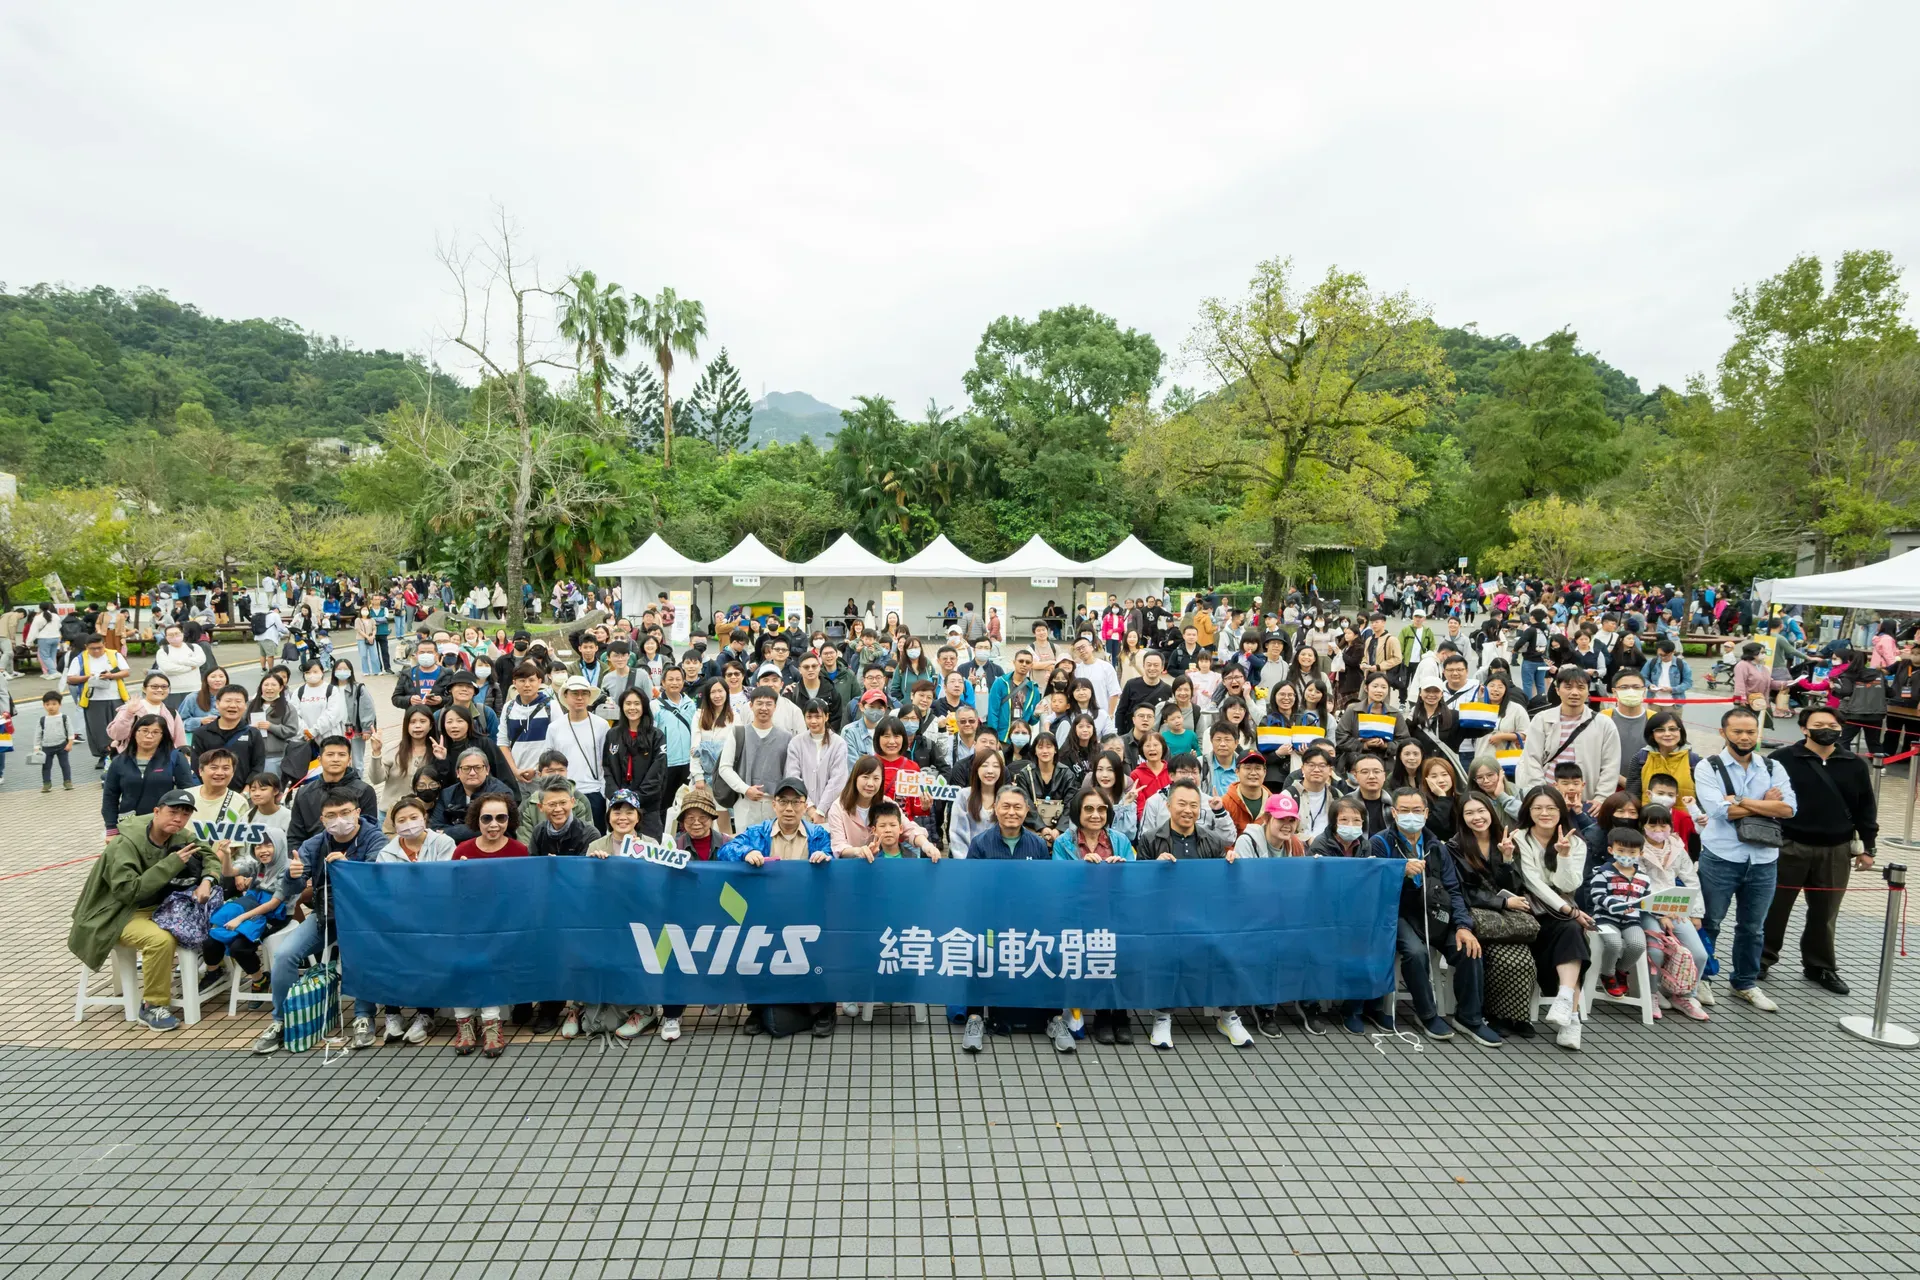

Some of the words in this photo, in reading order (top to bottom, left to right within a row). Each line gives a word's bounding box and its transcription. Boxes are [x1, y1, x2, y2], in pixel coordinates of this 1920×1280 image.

[899, 772, 933, 785] Let's
[222, 790, 234, 812] KANGO
[623, 837, 631, 855] I
[877, 926, 1117, 980] 緯創軟體
